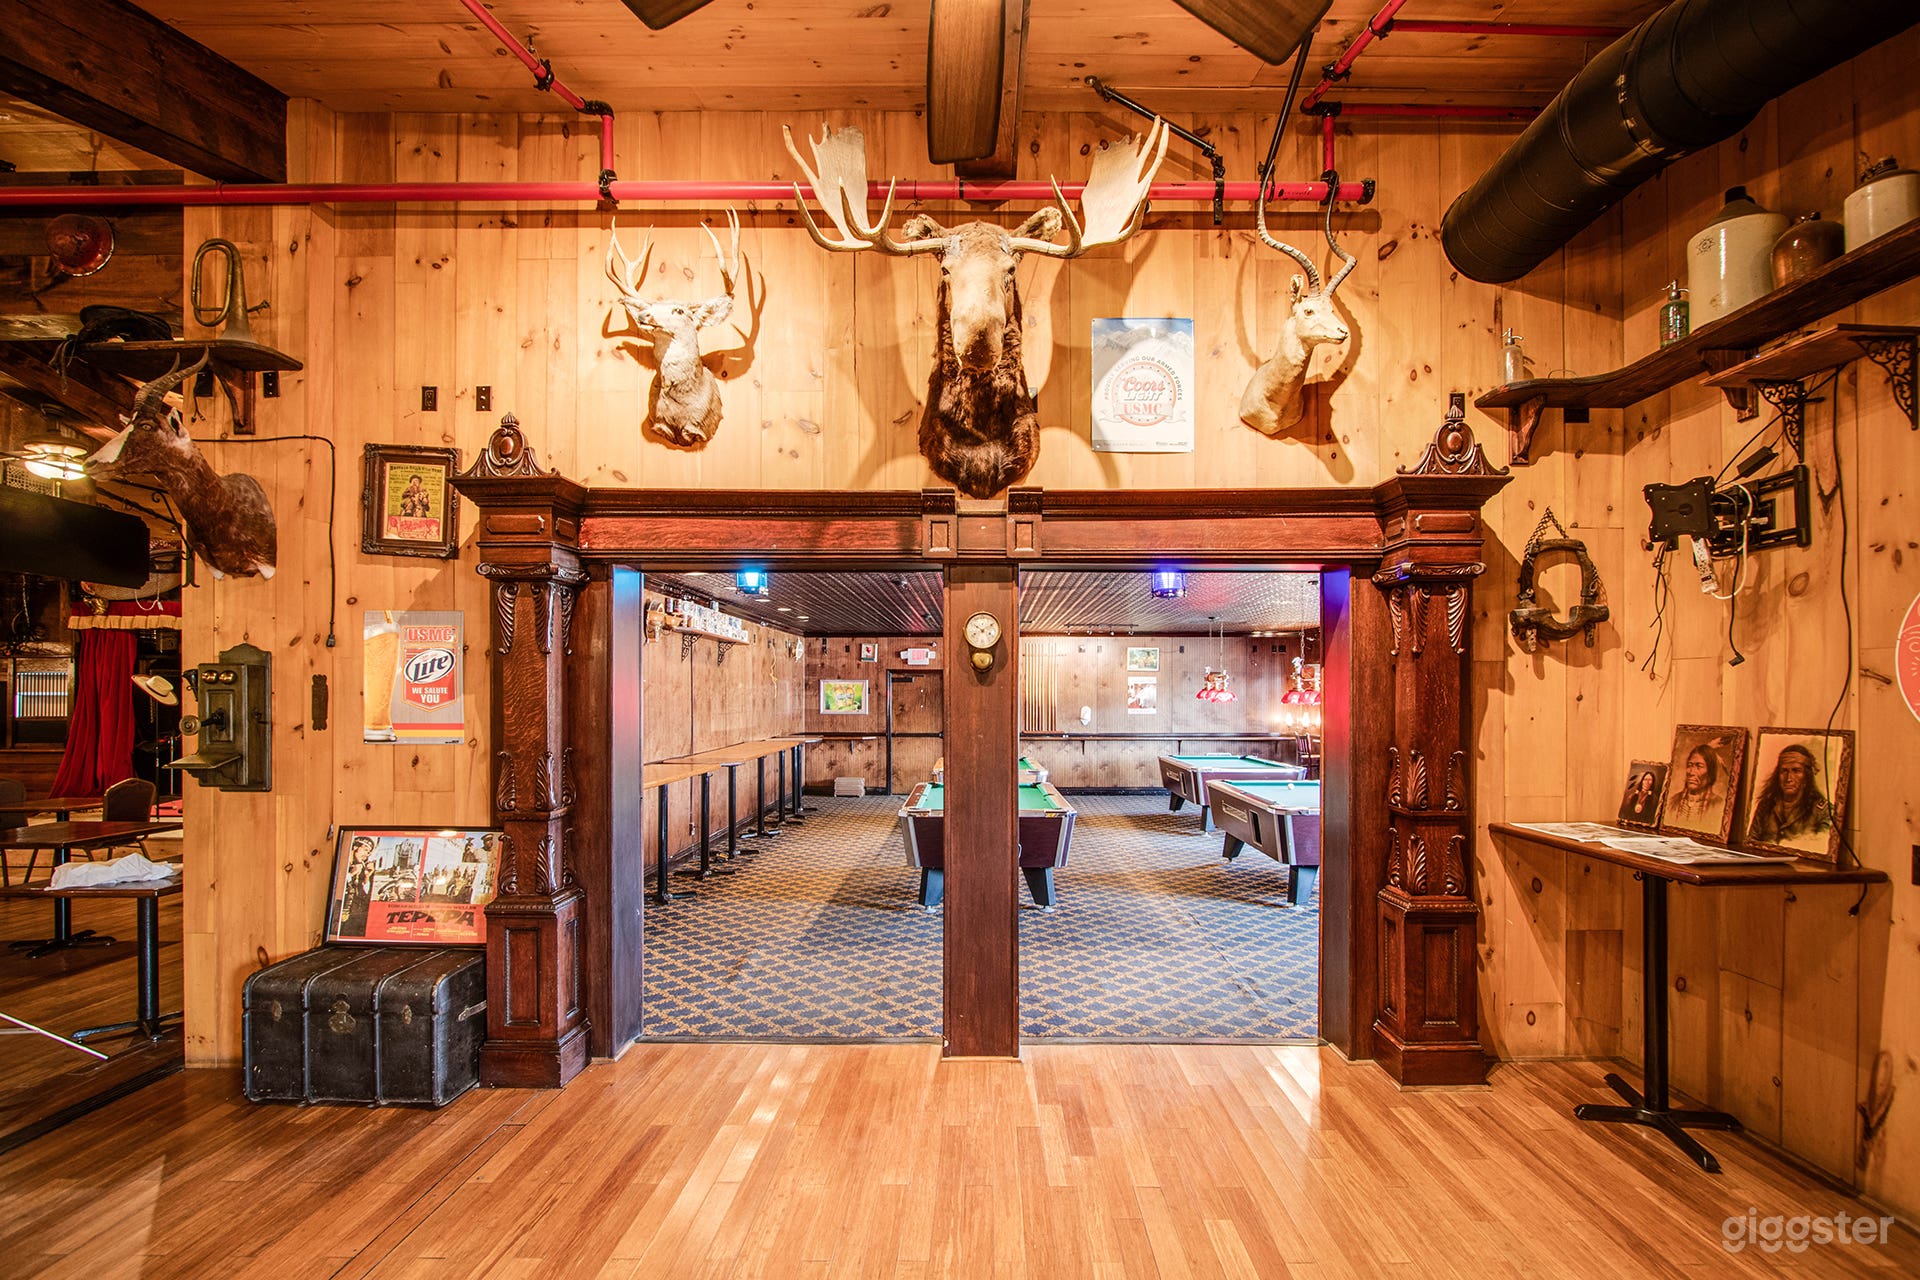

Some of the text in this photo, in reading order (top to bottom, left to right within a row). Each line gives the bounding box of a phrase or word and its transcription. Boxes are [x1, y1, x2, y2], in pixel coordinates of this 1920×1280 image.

[1122, 377, 1165, 391] Coors
[1156, 359, 1176, 376] ARMED
[1174, 375, 1183, 401] FORCES
[1124, 392, 1163, 401] LIGHT
[1123, 403, 1162, 415] USMC
[408, 627, 454, 642] USMC
[413, 655, 449, 682] Lite
[420, 694, 440, 703] YOU
[386, 910, 474, 927] TEPEPA
